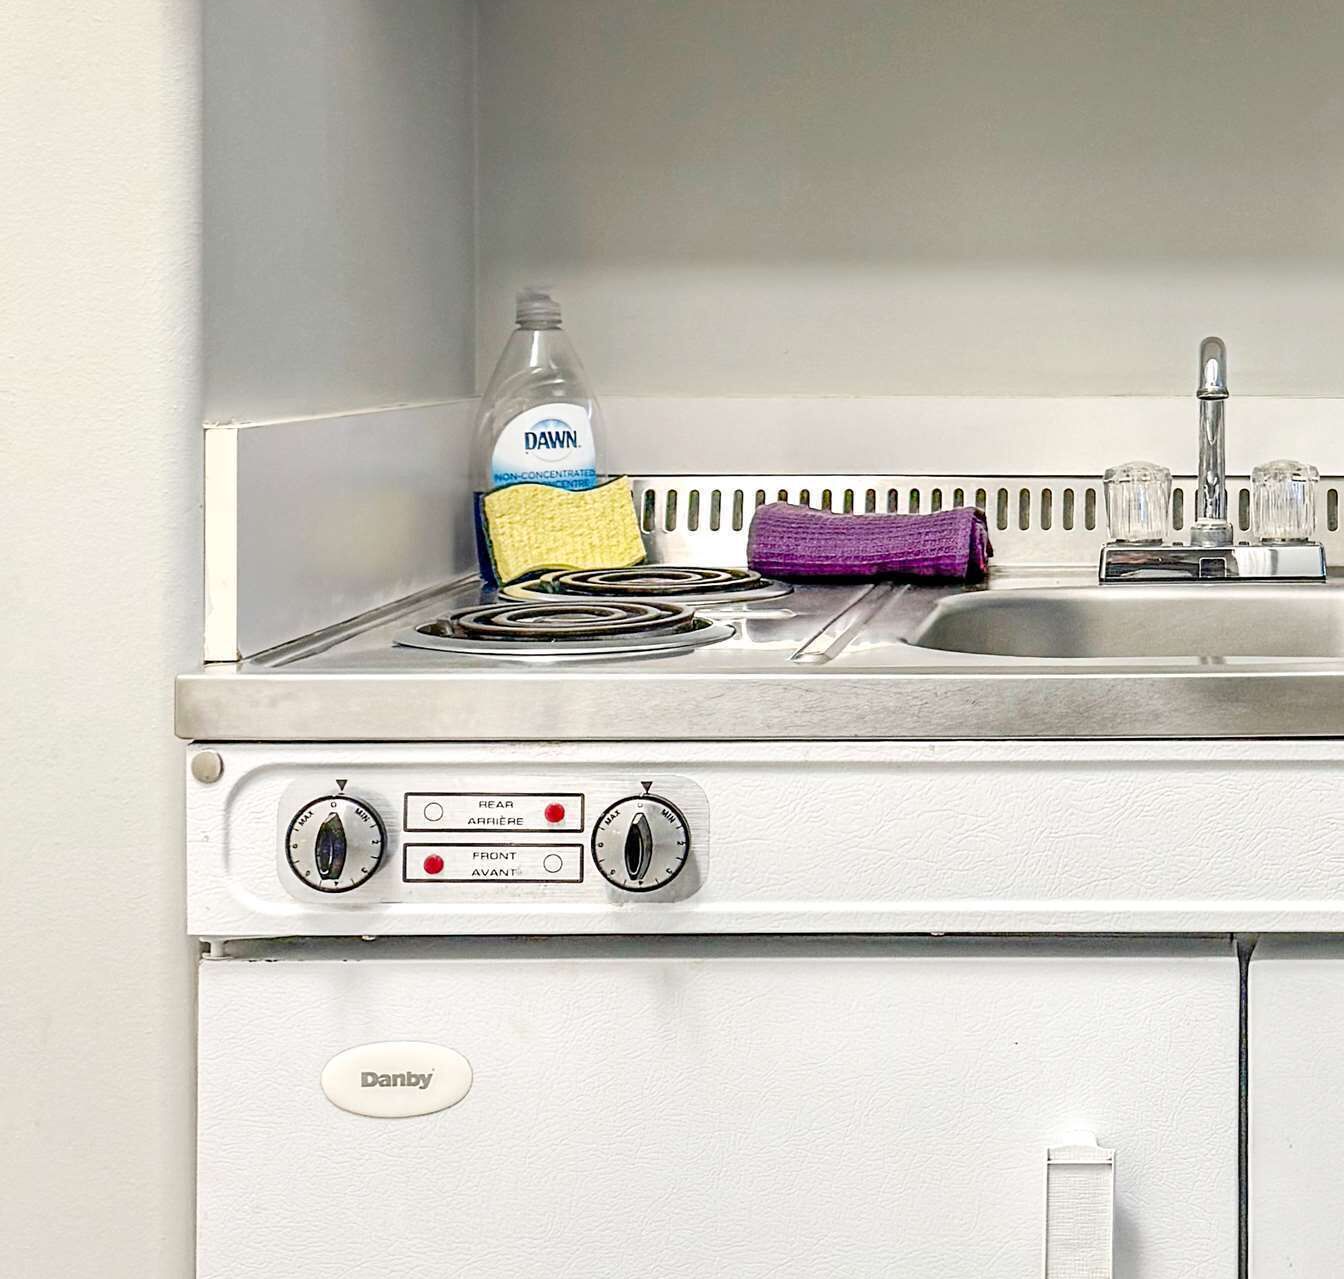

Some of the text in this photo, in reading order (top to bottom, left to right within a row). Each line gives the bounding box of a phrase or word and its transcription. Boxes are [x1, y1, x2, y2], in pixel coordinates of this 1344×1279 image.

[524, 430, 577, 450] DAWN
[494, 468, 596, 482] NON-CONCENTRATED
[479, 801, 514, 809] REAR
[298, 811, 314, 827] MAX
[355, 807, 370, 822] MIN
[467, 814, 524, 826] ARRIÈRE
[604, 810, 620, 825] MAX
[661, 808, 676, 823] MIN
[472, 852, 518, 860] FRONT
[471, 869, 517, 877] AVANT
[360, 1071, 434, 1090] Danby
